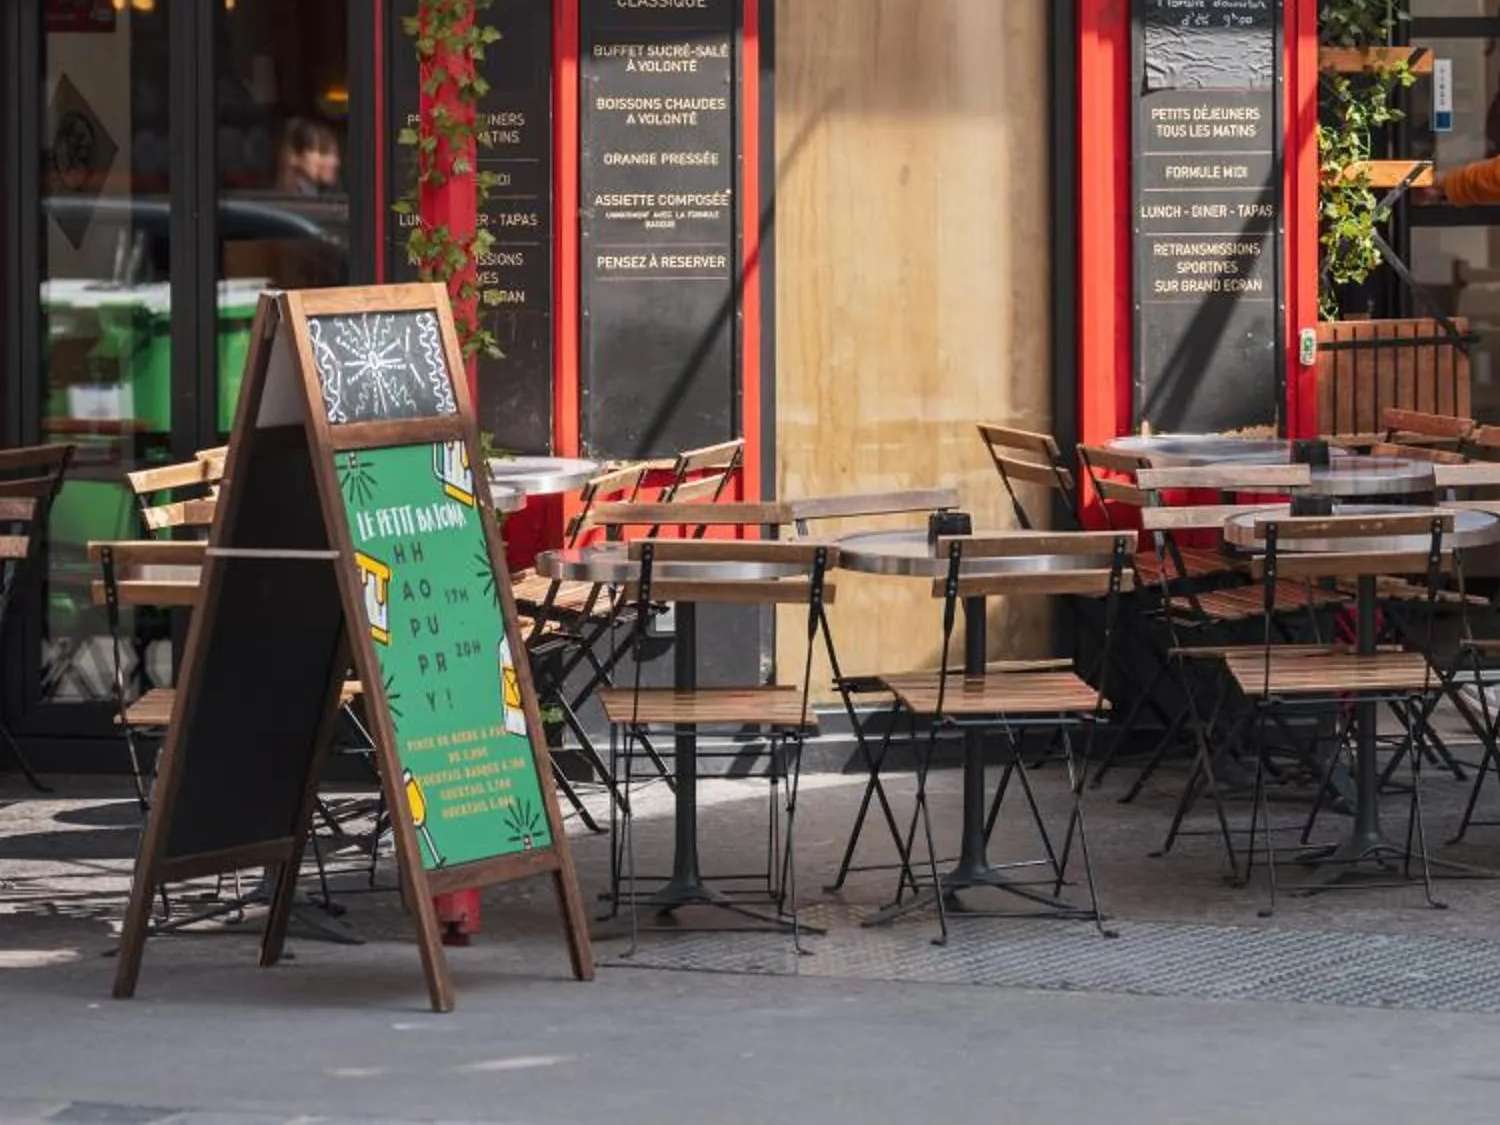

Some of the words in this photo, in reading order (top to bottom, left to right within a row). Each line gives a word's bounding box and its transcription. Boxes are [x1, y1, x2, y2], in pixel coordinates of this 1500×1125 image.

[593, 44, 645, 57] BUFFET
[647, 42, 729, 57] SUCRÉ-SALÉ
[638, 58, 697, 73] VOLONTÉ
[596, 98, 662, 111] BOISSONS
[664, 98, 726, 110] CHAUDES
[1151, 107, 1192, 120] PETITS
[1193, 103, 1261, 120] DÉJEUNERS
[638, 111, 698, 125] VOLONTÉ
[1156, 124, 1187, 138] TOUS
[1189, 124, 1210, 138] LES
[1212, 124, 1257, 137] MATINS
[603, 152, 657, 165] ORANGE
[660, 150, 719, 165] PRESSÉE
[1165, 166, 1221, 179] FORMULE
[1222, 166, 1249, 179] MIDI
[594, 194, 655, 206] ASSIETTE
[1141, 205, 1181, 219] LUNCH
[1191, 205, 1228, 218] DINER
[1237, 204, 1273, 218] TAPAS
[500, 213, 538, 227] TAPAS
[1153, 242, 1261, 257] RETRANSMISSIONS
[597, 255, 647, 269] PENSEZ
[649, 252, 659, 268] À
[660, 255, 727, 269] RESERVER
[1176, 260, 1238, 274] SPORTIVES
[1154, 280, 1179, 293] SUR
[1180, 279, 1221, 293] GRAND
[1223, 278, 1263, 292] ECRAN
[355, 509, 376, 543] LE
[376, 504, 416, 538] PETIT
